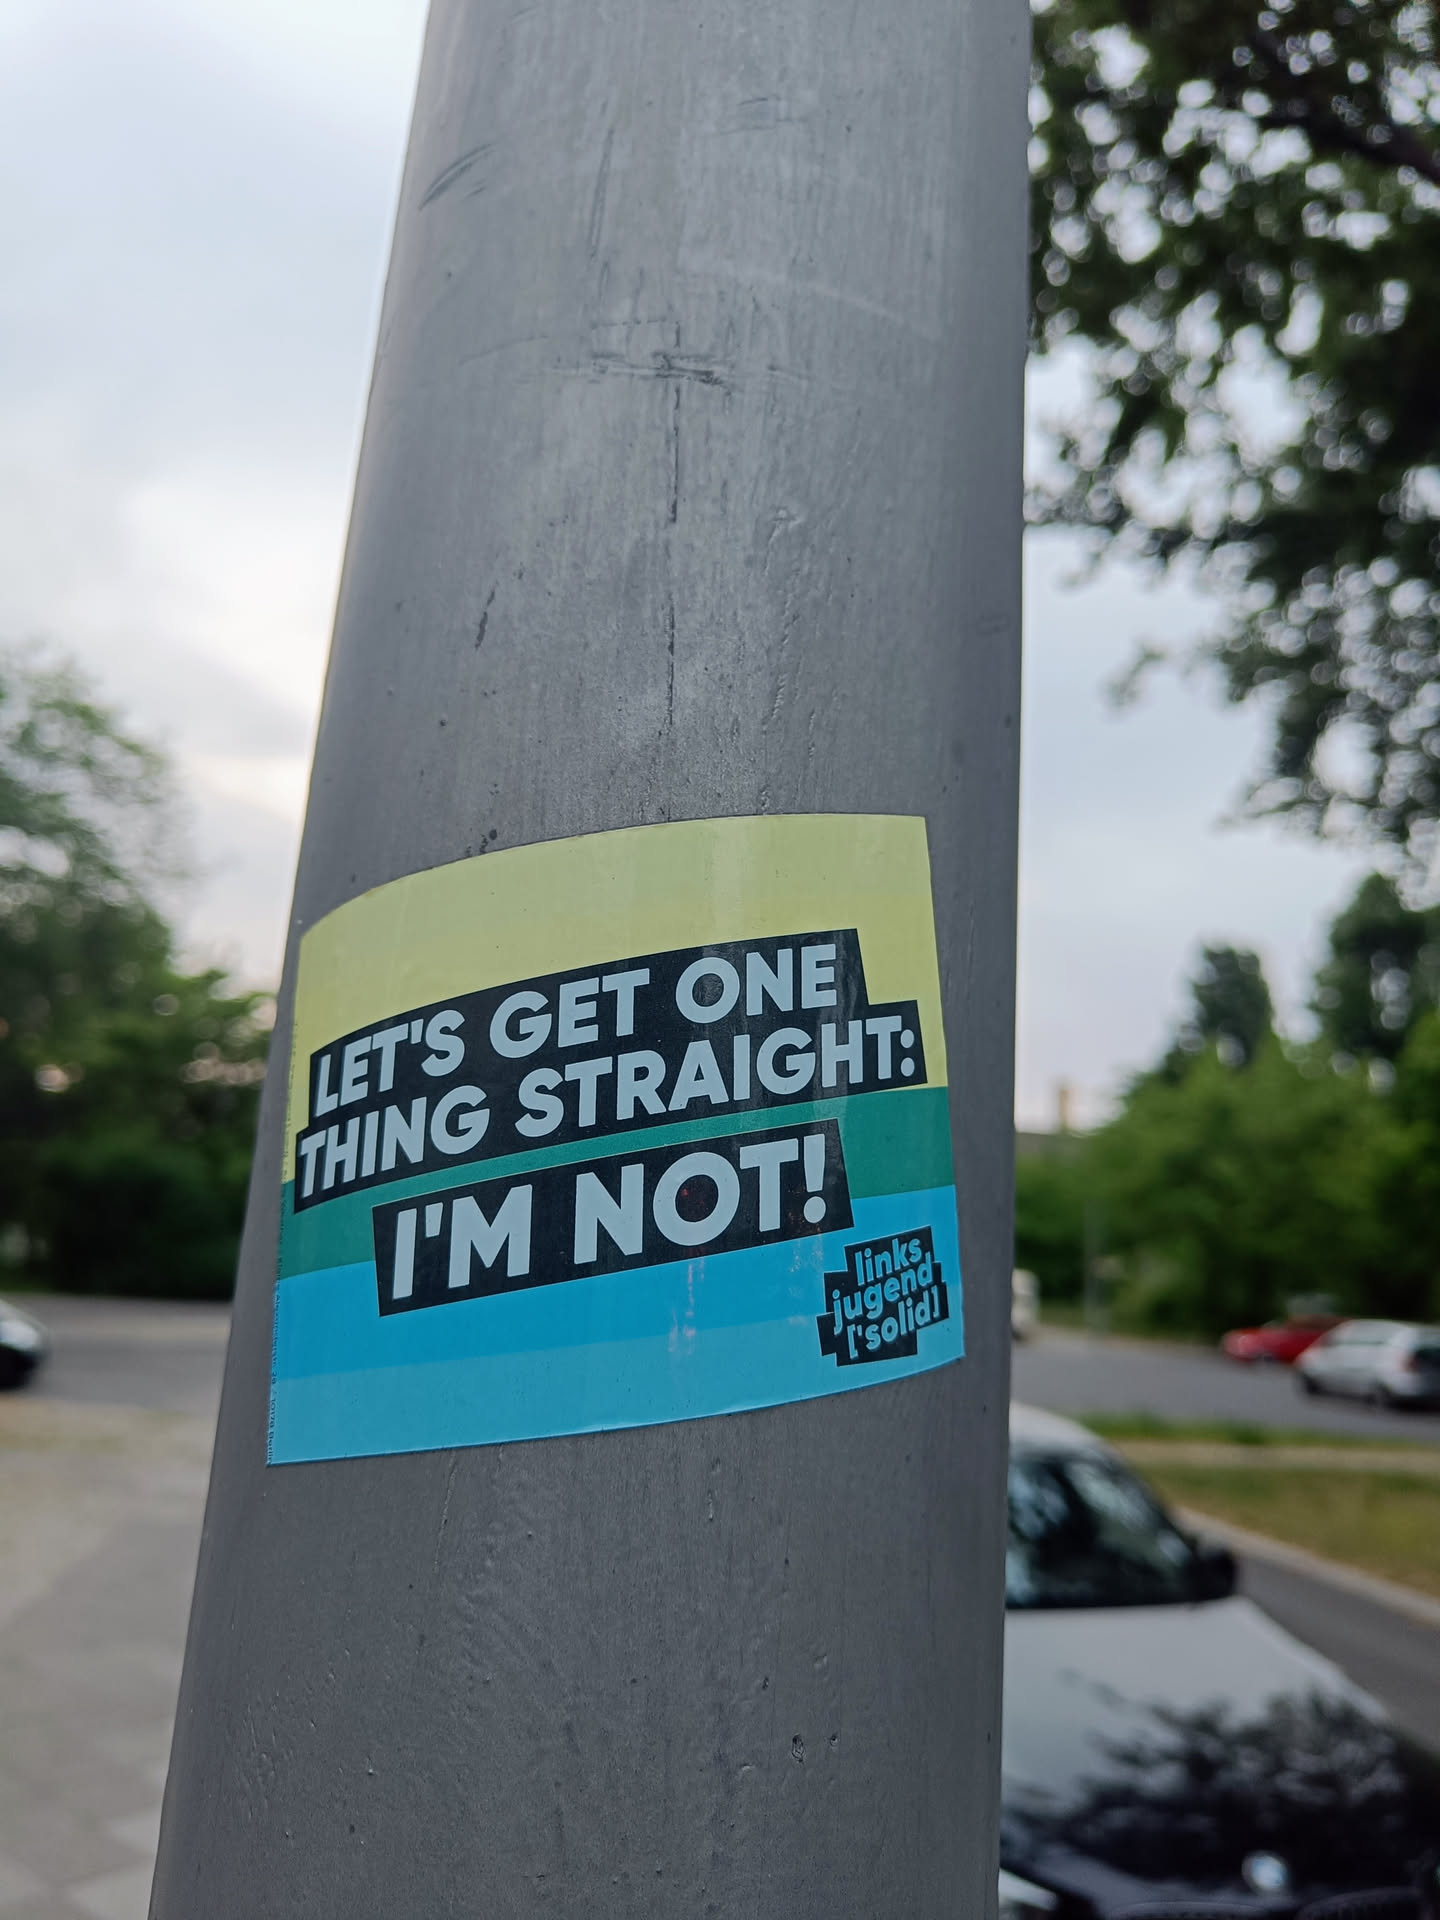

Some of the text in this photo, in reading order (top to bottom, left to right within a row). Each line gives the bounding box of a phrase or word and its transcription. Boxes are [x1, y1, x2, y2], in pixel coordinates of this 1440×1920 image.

[300, 1086, 491, 1199] THING
[514, 1015, 915, 1138] STRAIGHT:
[314, 943, 839, 1118] LET'S GET ONE
[392, 1133, 827, 1300] I'M NOT!
[832, 1251, 934, 1336] jugend
[854, 1238, 922, 1287] links
